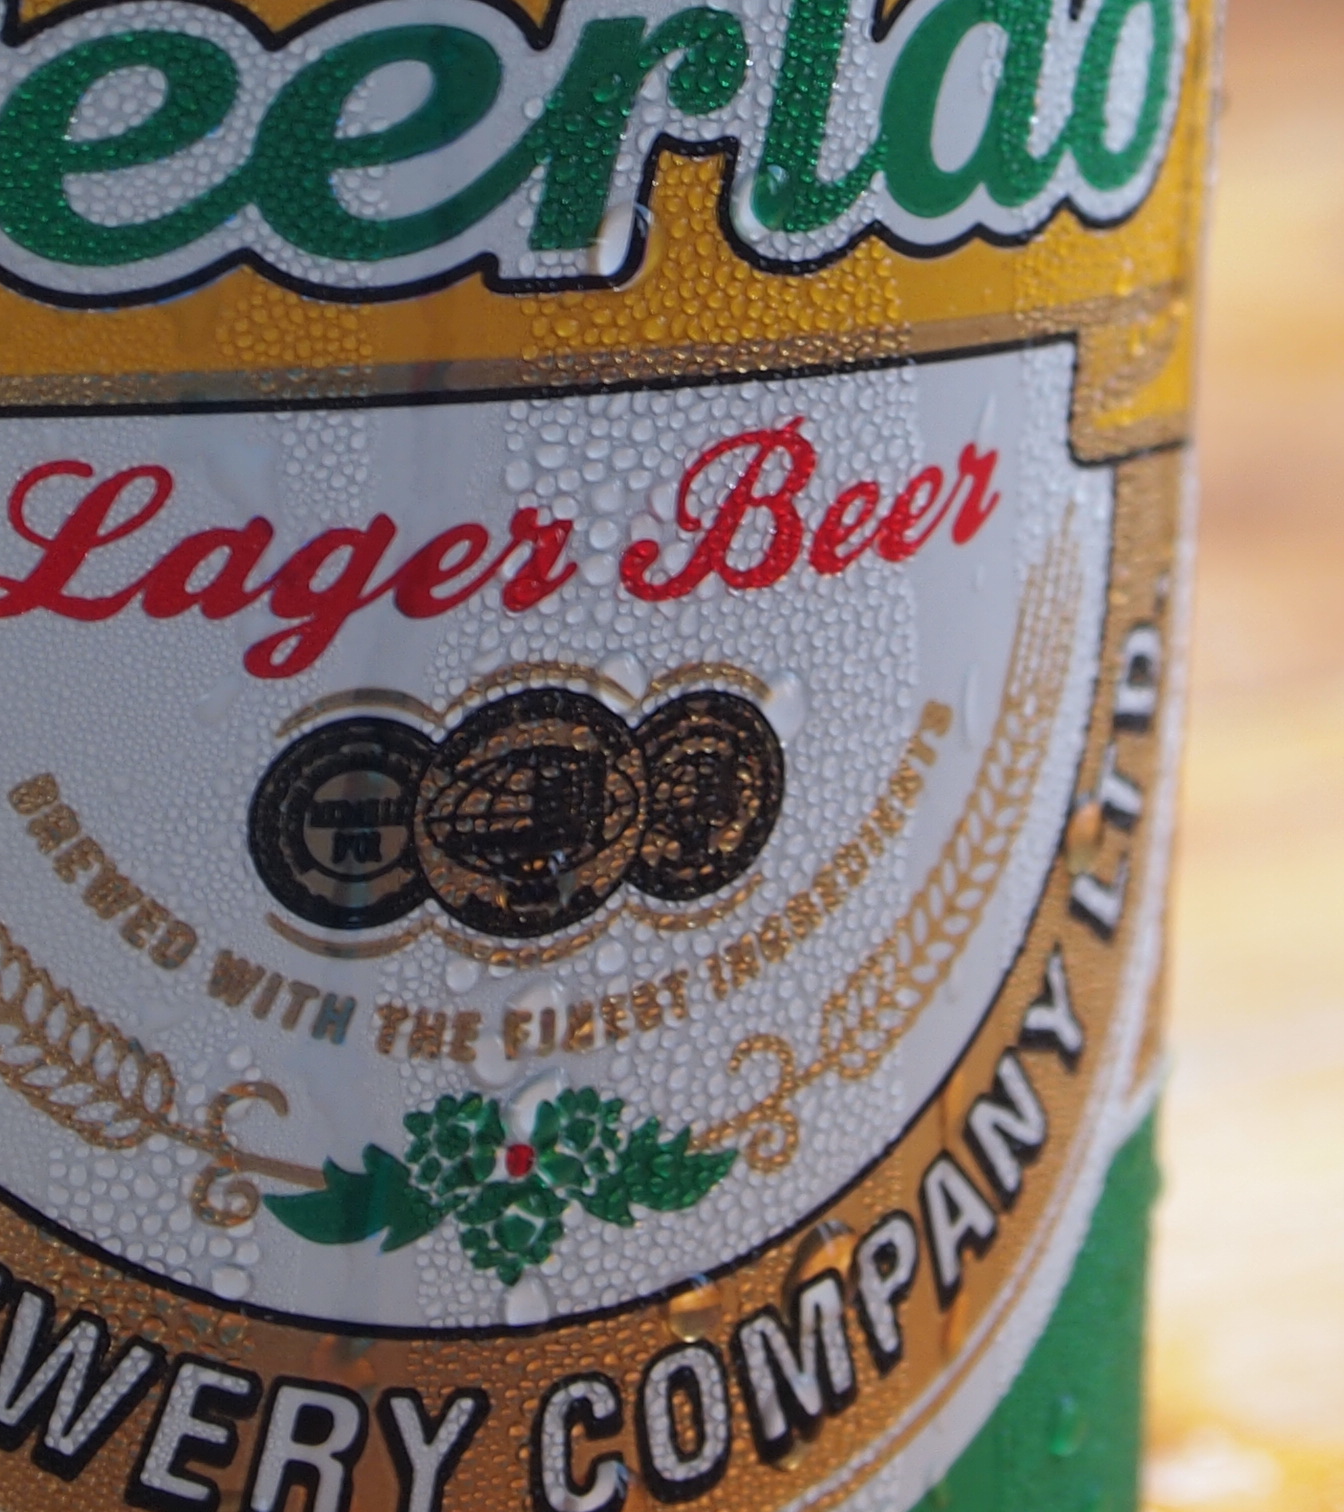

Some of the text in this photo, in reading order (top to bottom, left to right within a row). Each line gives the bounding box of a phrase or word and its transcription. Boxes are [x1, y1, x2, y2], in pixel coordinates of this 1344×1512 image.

[620, 414, 1002, 602] Beer
[8, 771, 199, 971] BREWED
[208, 948, 357, 1046] WITH
[374, 998, 483, 1064] THE
[528, 942, 1087, 1512] COMPANY
